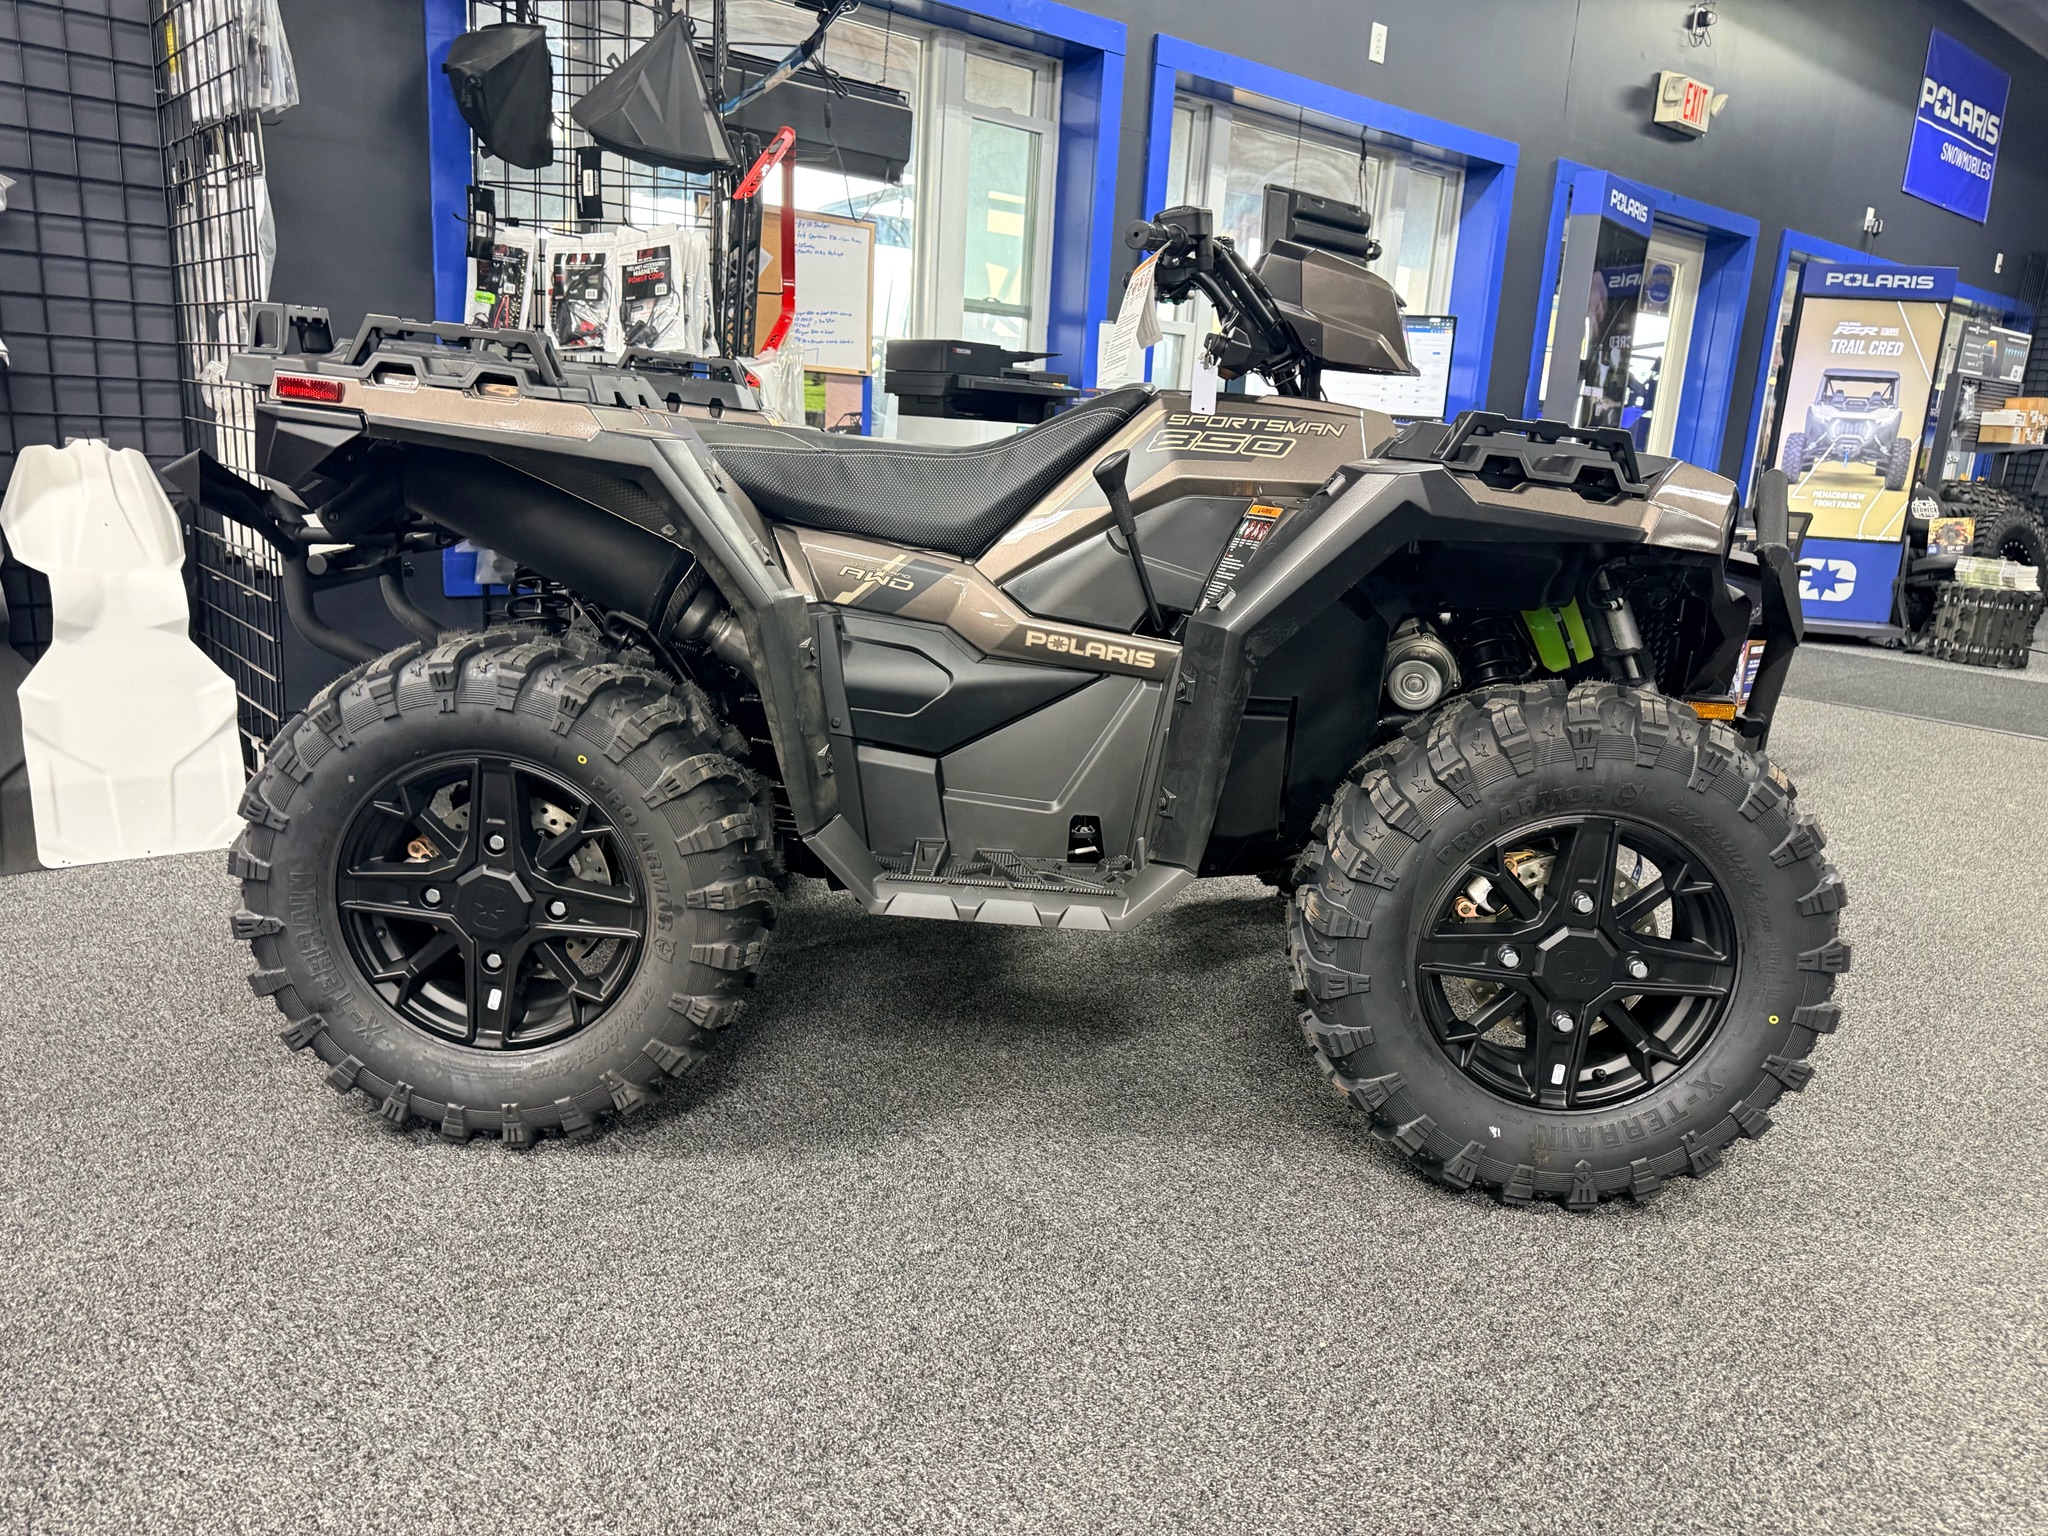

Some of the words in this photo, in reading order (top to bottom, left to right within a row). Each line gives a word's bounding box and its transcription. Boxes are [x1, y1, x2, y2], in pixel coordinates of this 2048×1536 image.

[1683, 82, 1708, 125] EXIT
[1920, 77, 2000, 145] POLARIS
[1940, 142, 1991, 180] SNOWMOBILES
[1610, 188, 1648, 223] POLARIS
[627, 275, 647, 284] POWER
[648, 272, 665, 280] CORD
[633, 266, 659, 277] MAGNETIC
[1825, 272, 1934, 290] POLARIS
[1830, 338, 1866, 355] TRAIL
[1868, 340, 1904, 356] CRED
[1166, 414, 1346, 437] SPORTSMAN
[1813, 490, 1848, 499] MENACING
[1849, 491, 1866, 501] NEW
[1814, 499, 1837, 508] FRONT
[1837, 500, 1861, 509] FASCIA
[839, 566, 914, 591] AWD
[1025, 630, 1155, 668] POLARIS
[591, 774, 639, 826] PRO
[1436, 818, 1488, 865] PRO
[289, 872, 389, 1046] X-TERRAIN
[1535, 1070, 1726, 1150] X-TERRAIN
